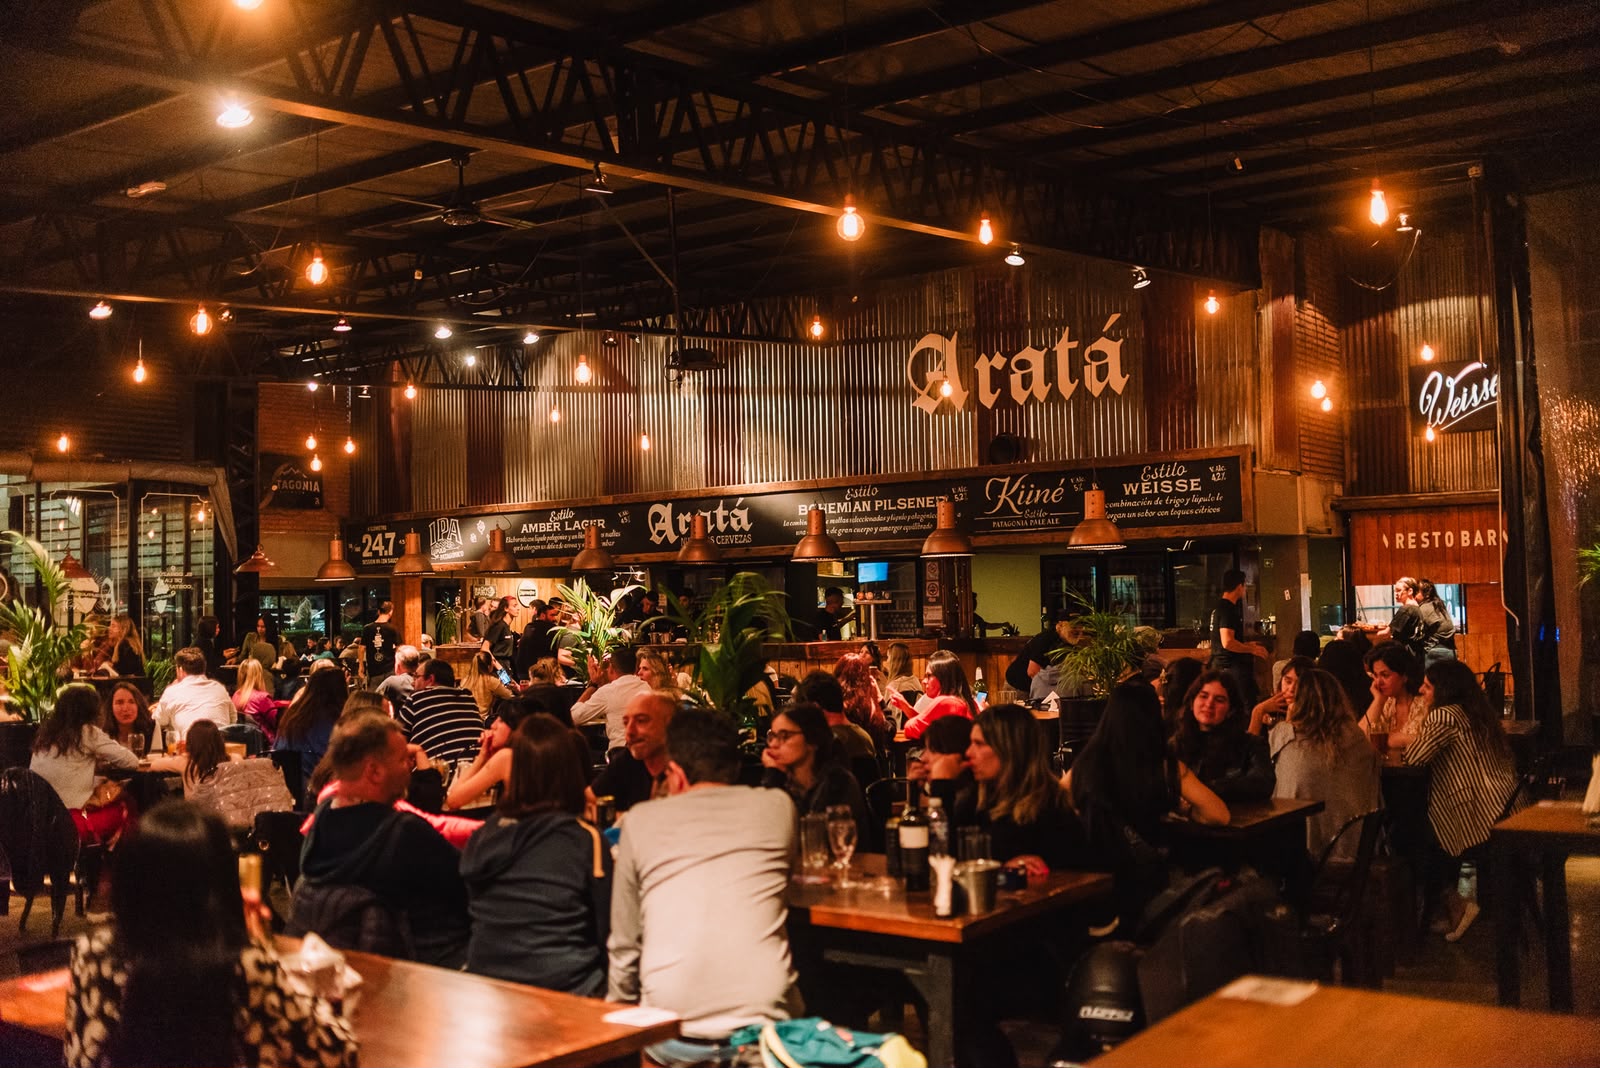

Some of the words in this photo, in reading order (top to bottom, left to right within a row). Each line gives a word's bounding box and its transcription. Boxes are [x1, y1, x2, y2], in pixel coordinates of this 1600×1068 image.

[907, 313, 1130, 415] Aratá
[1141, 462, 1187, 481] Estilo
[844, 485, 879, 500] Estilo
[1122, 478, 1202, 495] WEISSE
[1154, 496, 1163, 505] de
[1165, 495, 1185, 508] trigo
[1185, 497, 1191, 506] y
[549, 508, 575, 522] Estilo
[1137, 508, 1155, 518] sabor
[1170, 507, 1194, 519] toques
[520, 521, 561, 534] AMBER
[992, 519, 1028, 528] PATAGONIA
[1029, 518, 1045, 526] PALE
[429, 517, 463, 546] IPA
[361, 532, 396, 557] 24.7
[716, 534, 752, 545] CERVEZAS
[1395, 530, 1455, 550] RESTO
[1460, 529, 1498, 547] BAR
